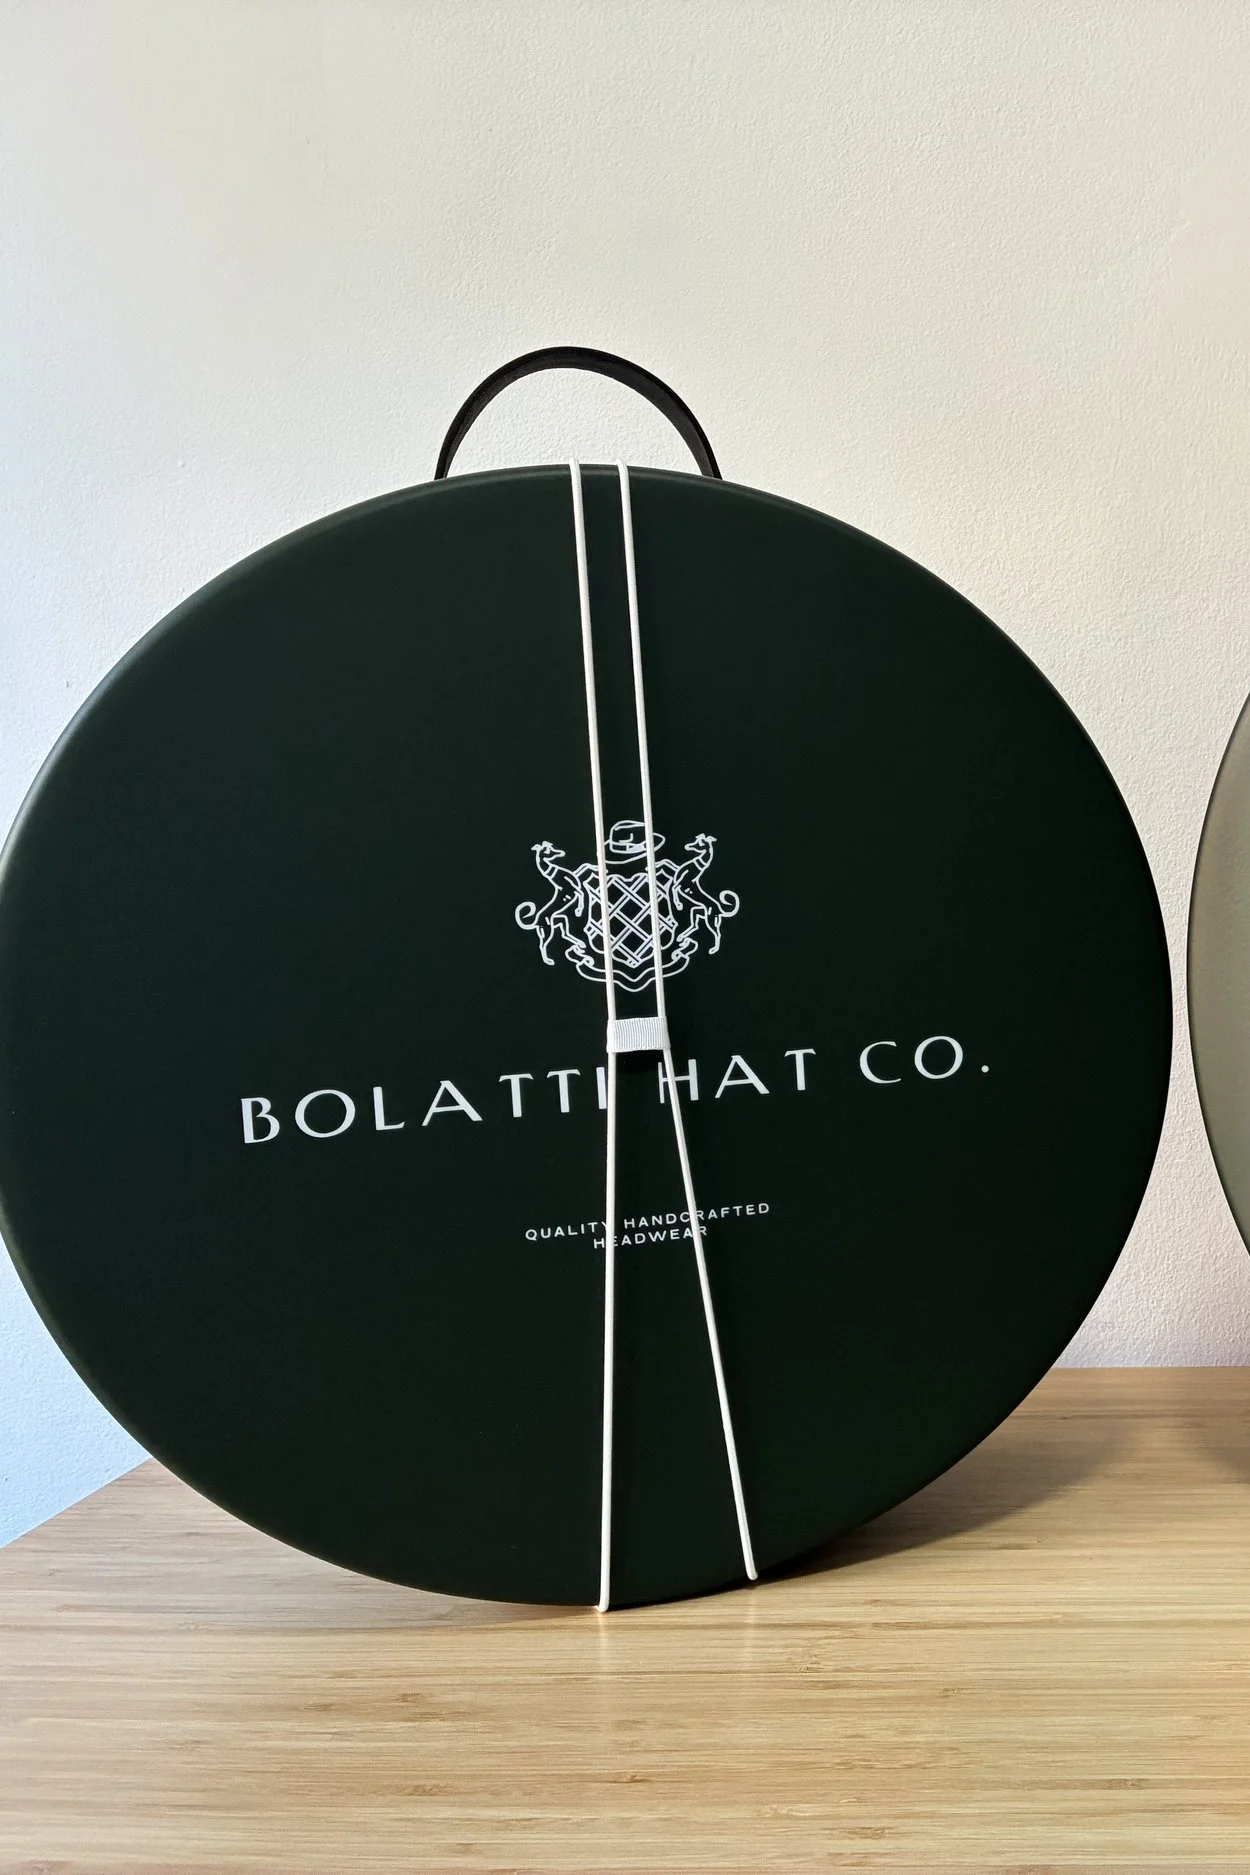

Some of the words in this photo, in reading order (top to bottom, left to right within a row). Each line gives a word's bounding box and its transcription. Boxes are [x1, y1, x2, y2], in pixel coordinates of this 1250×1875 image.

[240, 1066, 607, 1144] BOLATTI
[657, 1048, 816, 1104] HAT
[859, 1035, 990, 1084] CO.
[623, 1203, 770, 1229] HANDCRAFTED
